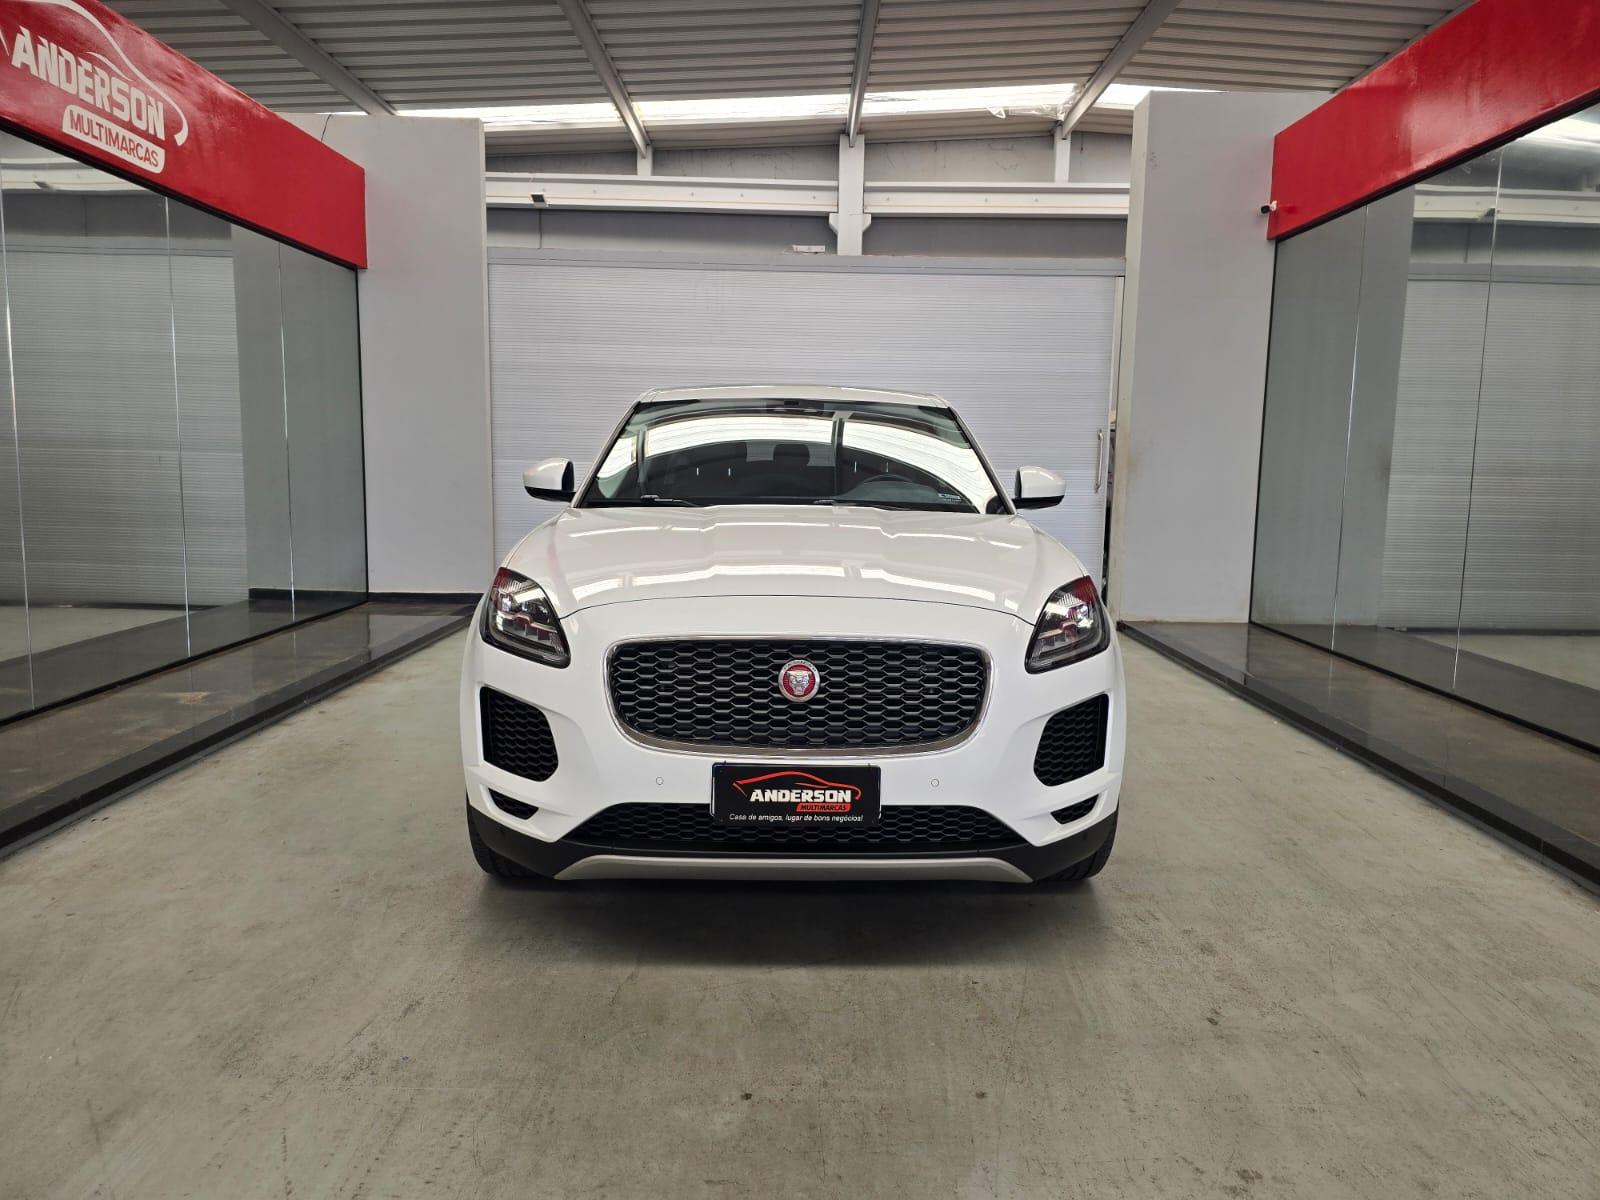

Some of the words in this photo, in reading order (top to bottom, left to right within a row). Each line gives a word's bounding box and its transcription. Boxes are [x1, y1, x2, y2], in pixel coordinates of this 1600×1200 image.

[11, 25, 165, 141] ANDERSON
[69, 109, 159, 167] MULTIMARCAS
[750, 789, 852, 803] ANDERSON
[729, 813, 747, 821] Casa
[748, 813, 757, 821] de
[758, 814, 783, 823] amigos,
[785, 814, 802, 823] lugar
[813, 814, 830, 822] bons
[832, 814, 864, 823] negócios!
